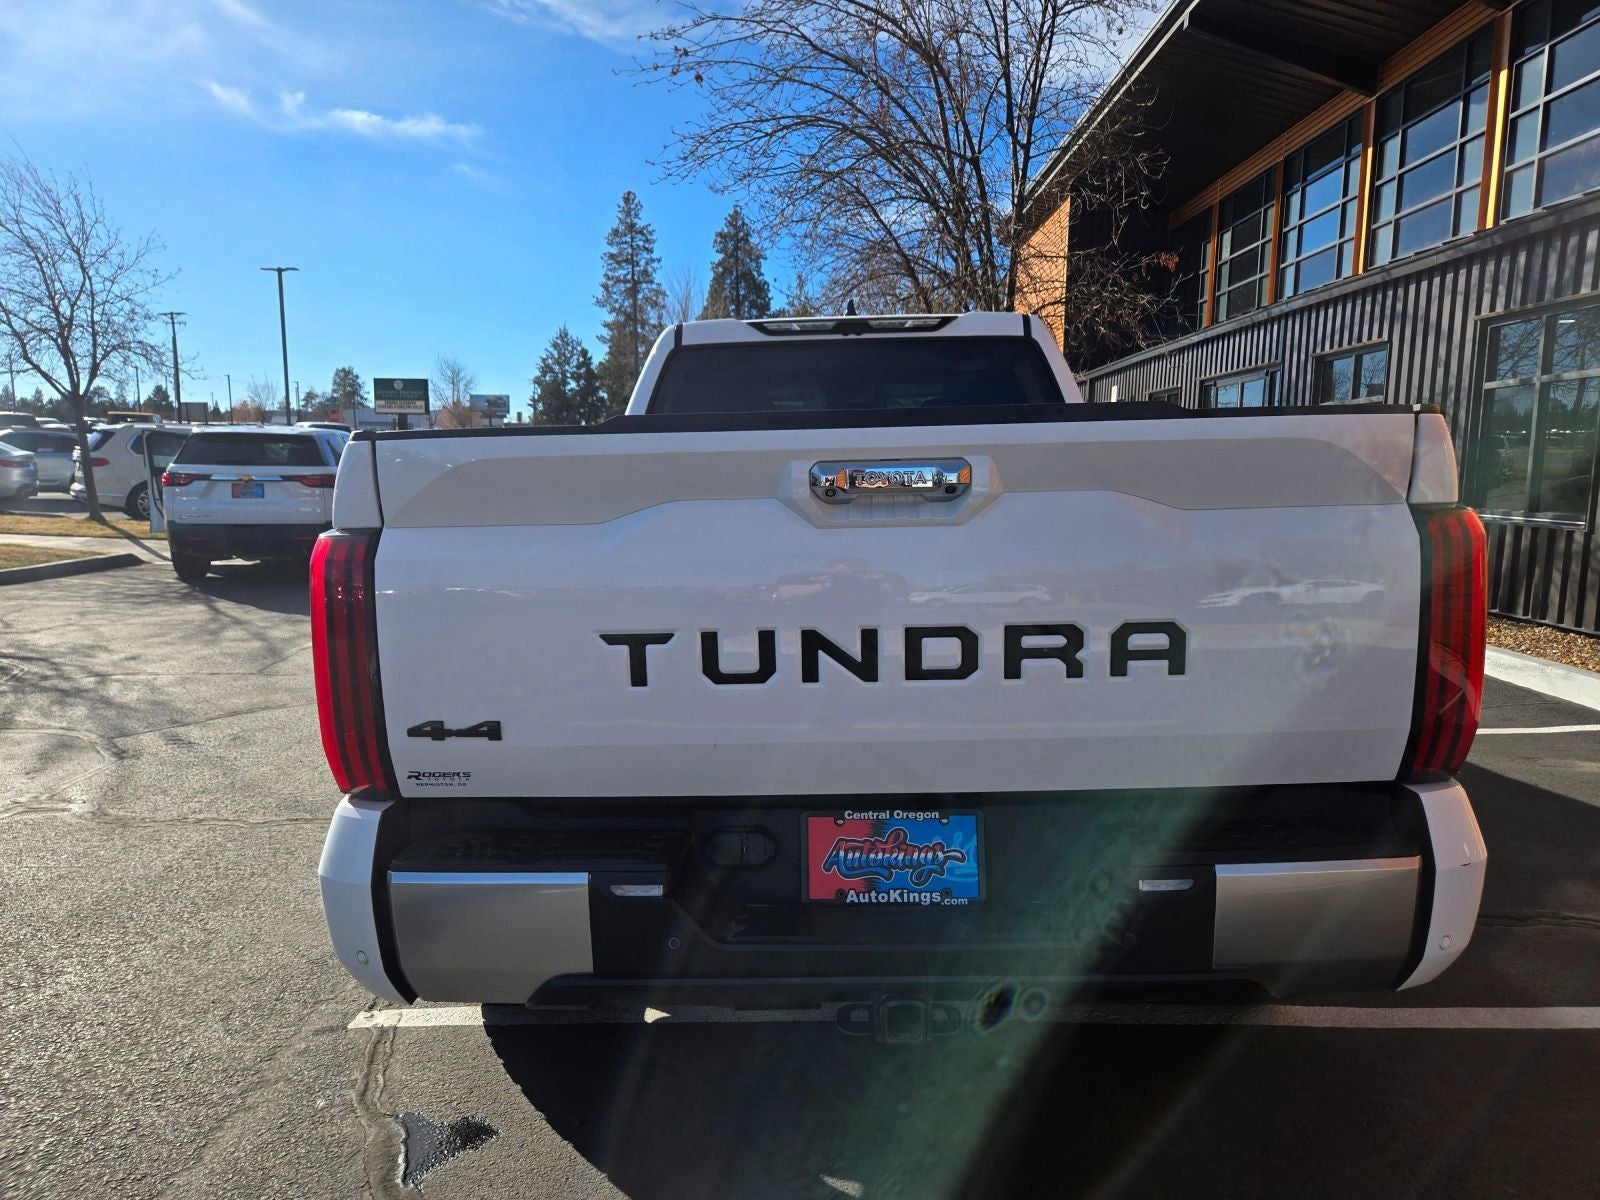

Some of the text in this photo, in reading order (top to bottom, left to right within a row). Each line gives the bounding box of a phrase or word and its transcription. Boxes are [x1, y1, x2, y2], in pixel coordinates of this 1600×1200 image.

[853, 470, 928, 486] TOYOTA
[598, 620, 1188, 688] TUNDRA
[844, 809, 940, 822] Central Oregon
